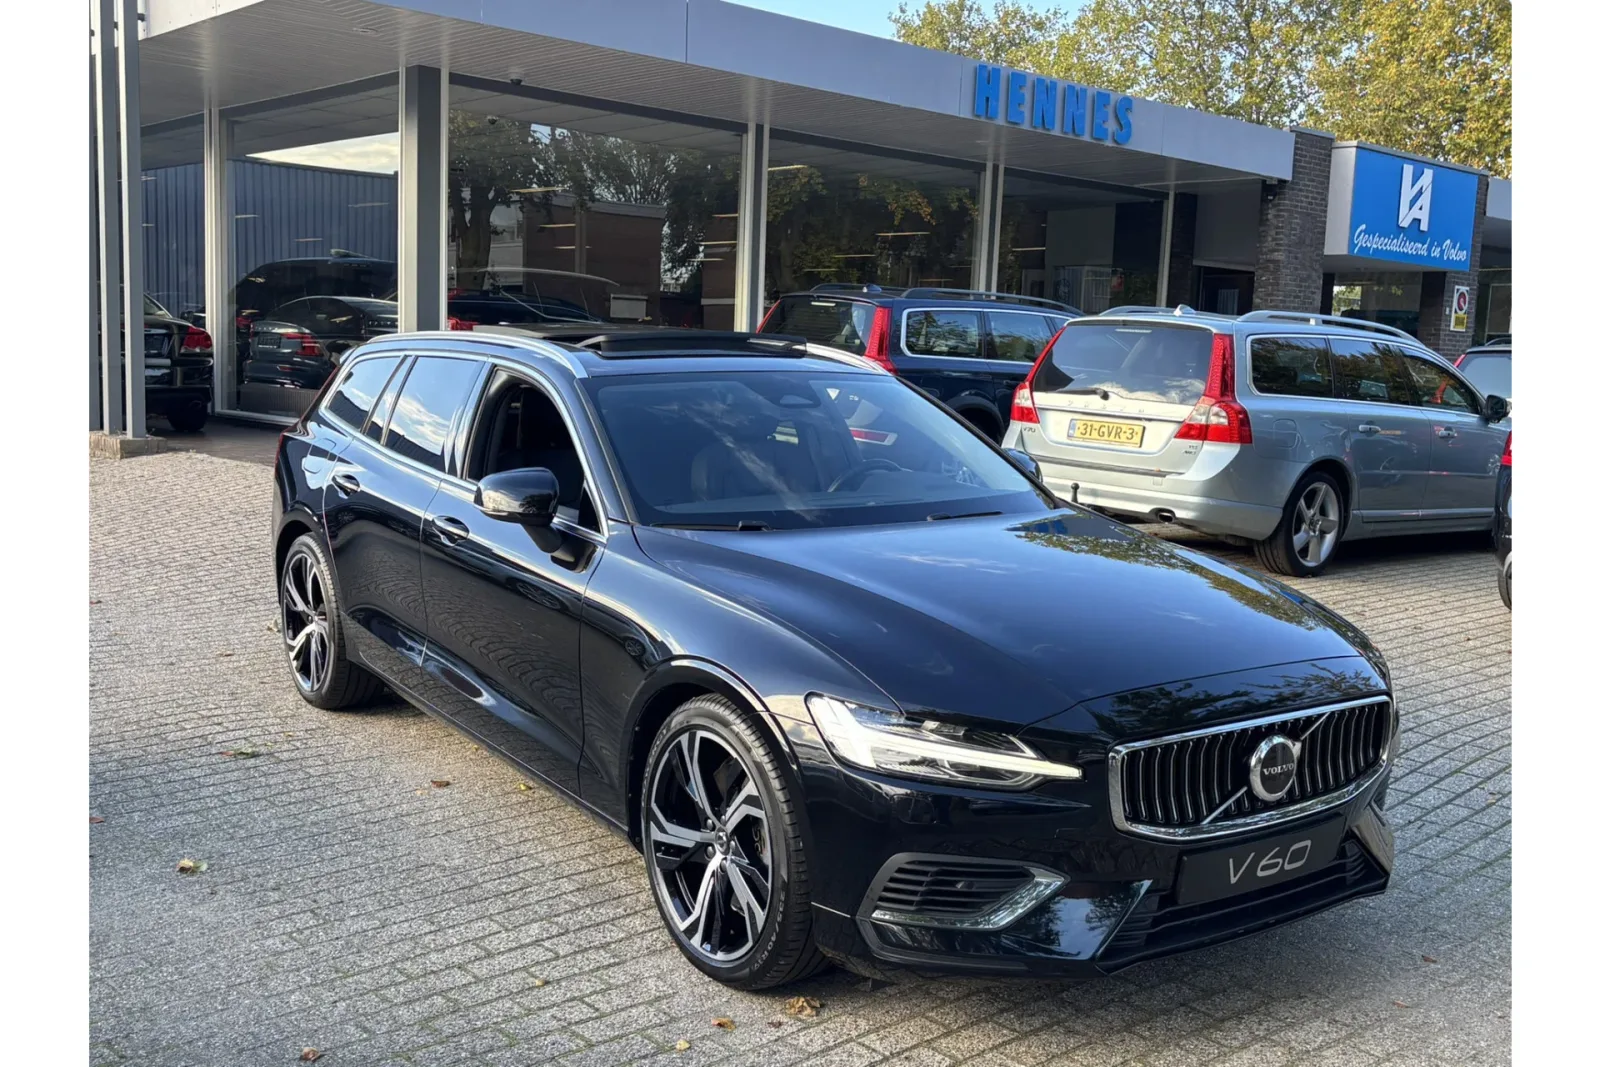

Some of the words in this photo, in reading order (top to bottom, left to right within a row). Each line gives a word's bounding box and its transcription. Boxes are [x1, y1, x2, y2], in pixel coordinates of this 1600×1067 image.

[974, 63, 1133, 145] HENNES
[1354, 223, 1430, 256] Gespecialiseerd
[1430, 241, 1441, 258] in
[1442, 239, 1467, 261] Volvo
[1263, 763, 1294, 775] VOLVO
